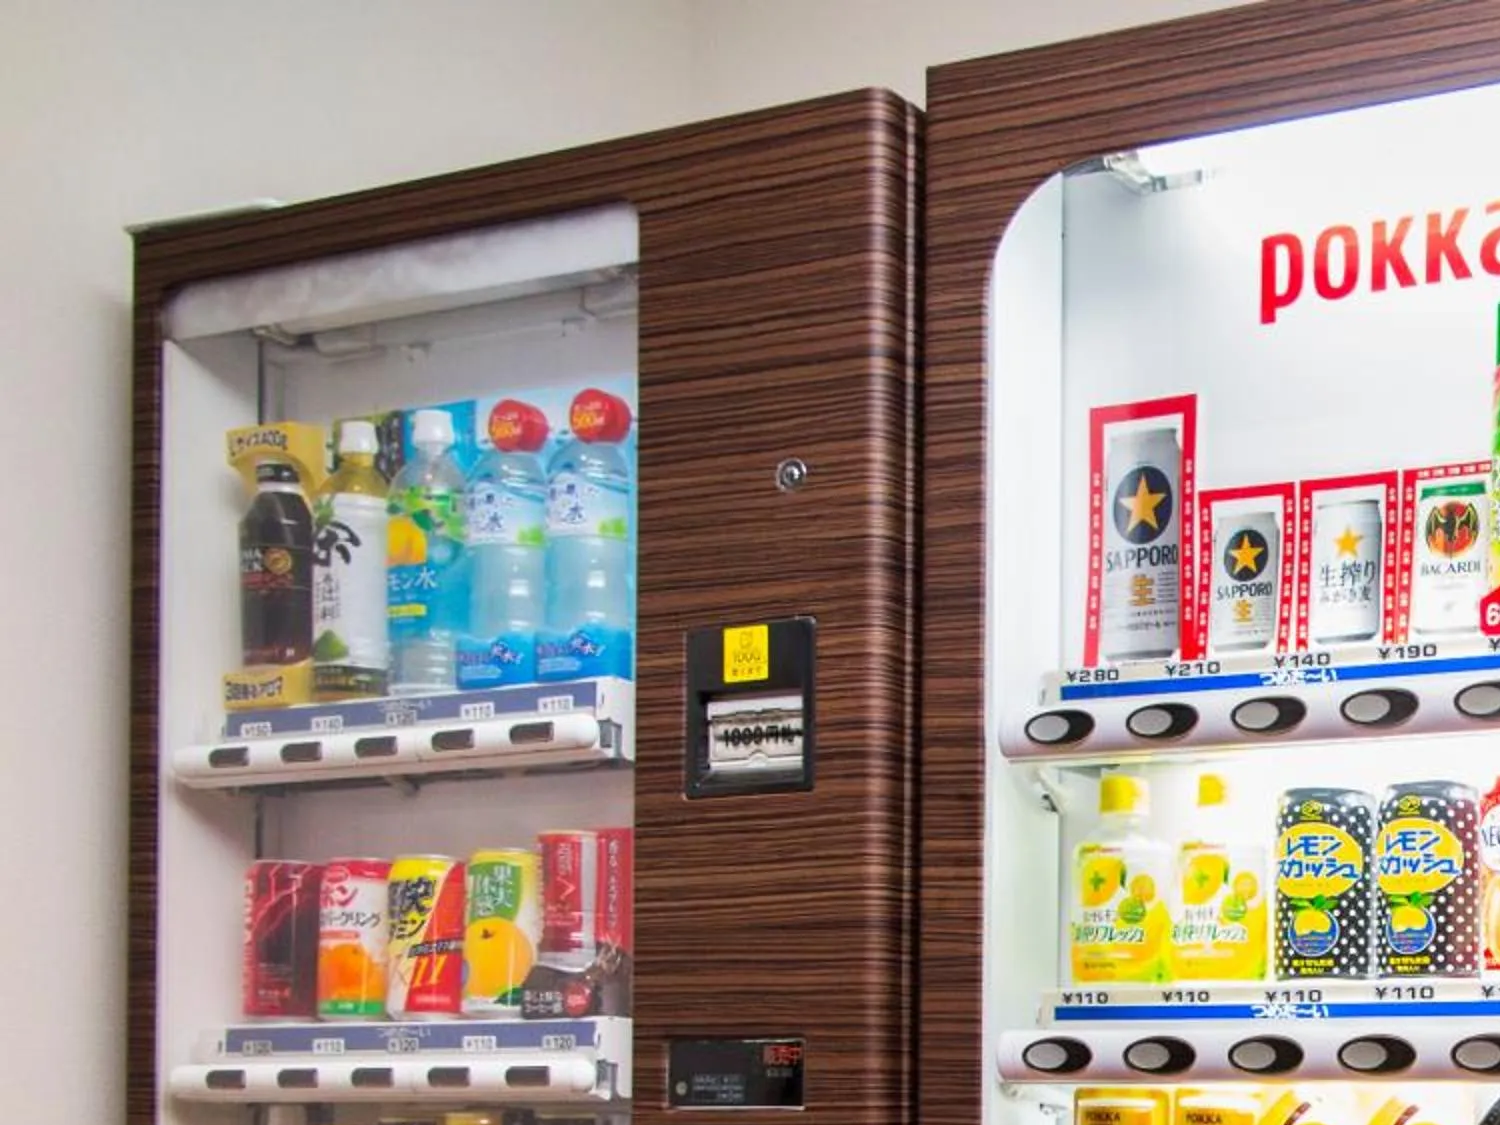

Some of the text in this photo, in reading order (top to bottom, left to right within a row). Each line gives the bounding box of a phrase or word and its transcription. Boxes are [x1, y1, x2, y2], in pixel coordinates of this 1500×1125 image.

[1105, 544, 1178, 572] SAPPORO
[1420, 559, 1482, 577] BACARDI
[386, 566, 439, 592] モン水
[1378, 643, 1438, 660] ¥190
[1165, 661, 1221, 677] ¥210
[1274, 653, 1331, 669] ¥140
[1066, 668, 1119, 683] ¥280
[1286, 835, 1343, 856] レモン
[1385, 831, 1441, 851] レモン
[1062, 991, 1109, 1005] ¥110
[1162, 990, 1211, 1004] ¥110
[1265, 989, 1323, 1003] ¥110
[1375, 986, 1435, 1000] ¥110
